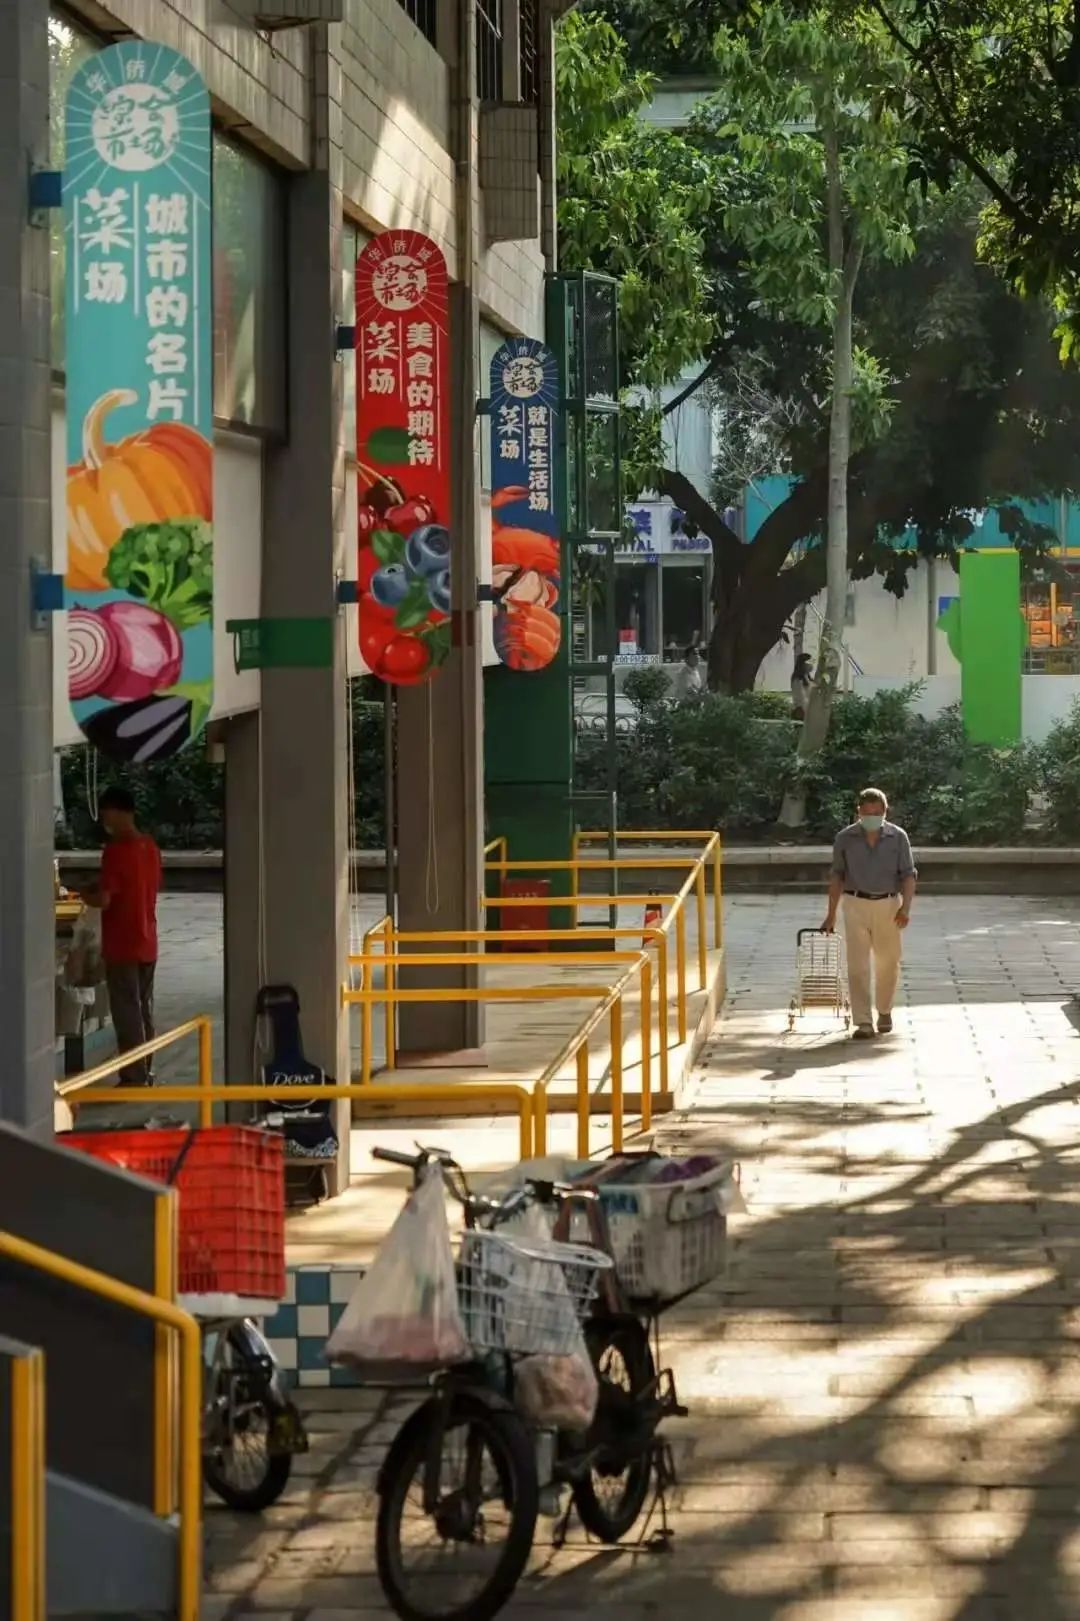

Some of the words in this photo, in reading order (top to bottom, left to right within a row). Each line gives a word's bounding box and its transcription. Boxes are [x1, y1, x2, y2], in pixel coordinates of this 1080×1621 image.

[80, 188, 134, 304] 菜场
[145, 193, 188, 421] 城市的名片
[364, 321, 400, 394] 菜场
[407, 322, 435, 466] 美食的期待
[498, 405, 522, 459] 菜场
[528, 406, 549, 512] 就是生活场
[273, 1071, 314, 1087] Dove
